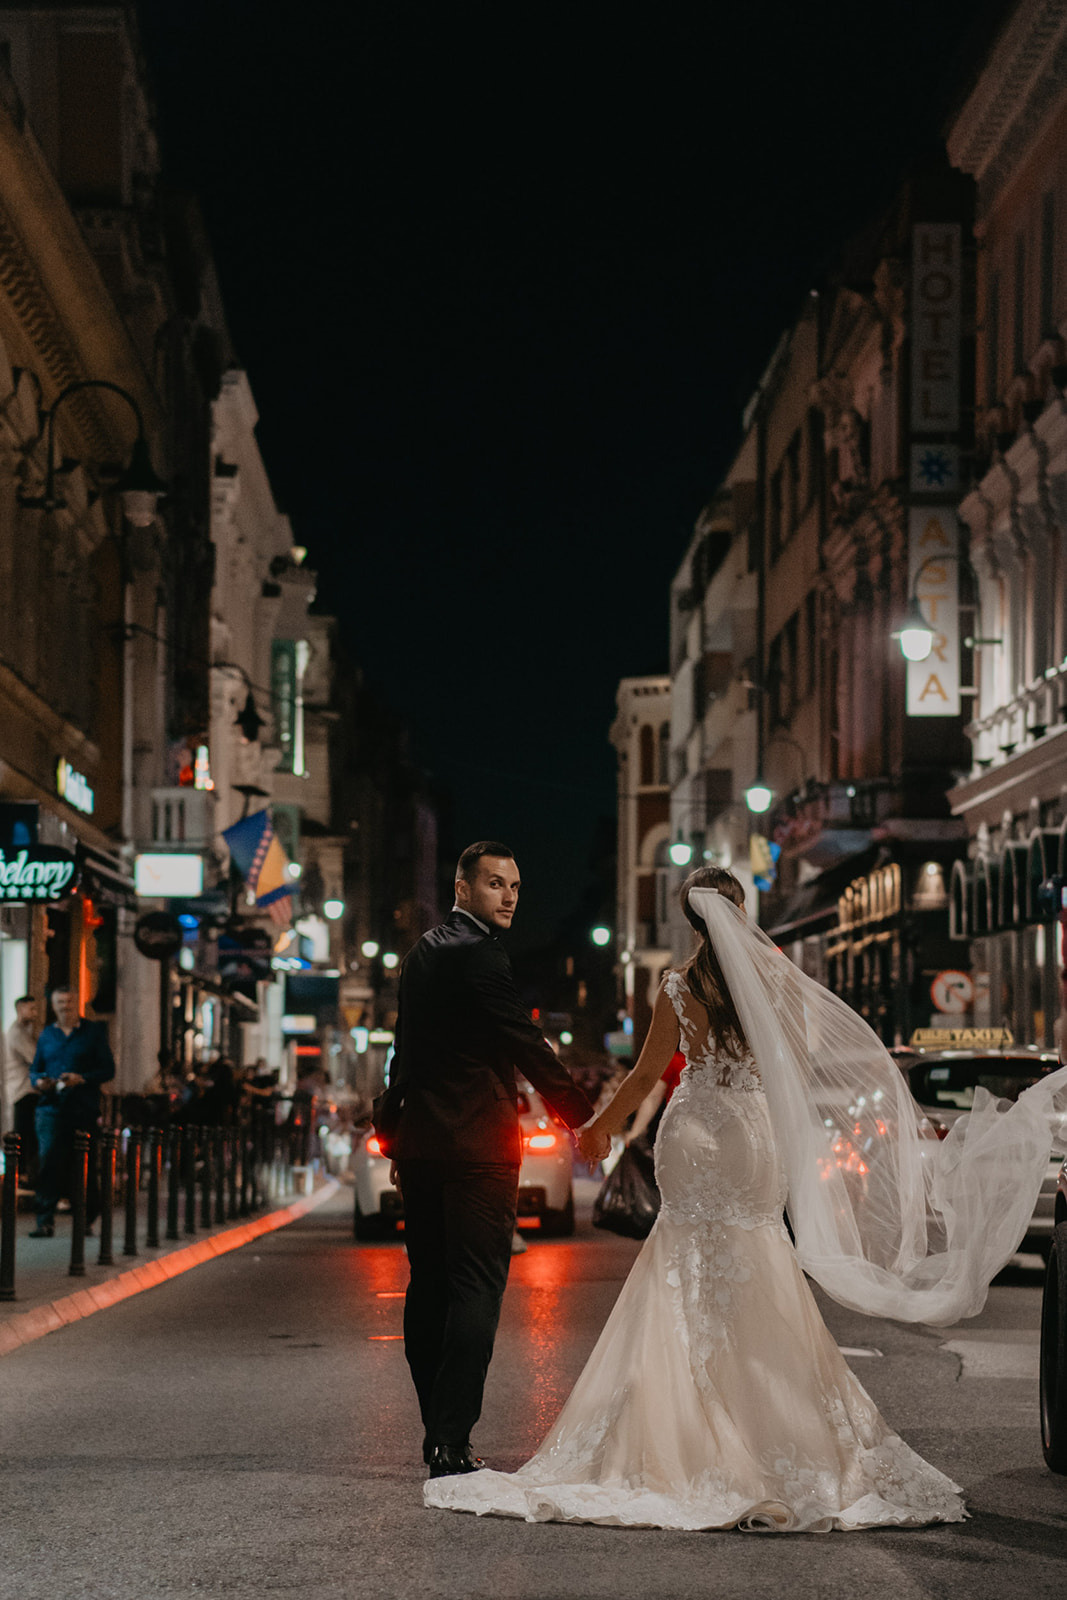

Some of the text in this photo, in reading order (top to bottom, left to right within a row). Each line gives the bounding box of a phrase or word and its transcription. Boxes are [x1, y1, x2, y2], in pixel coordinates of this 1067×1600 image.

[919, 233, 952, 420] HOTEL
[917, 515, 950, 702] ASTRA
[953, 1028, 991, 1041] TAXI
